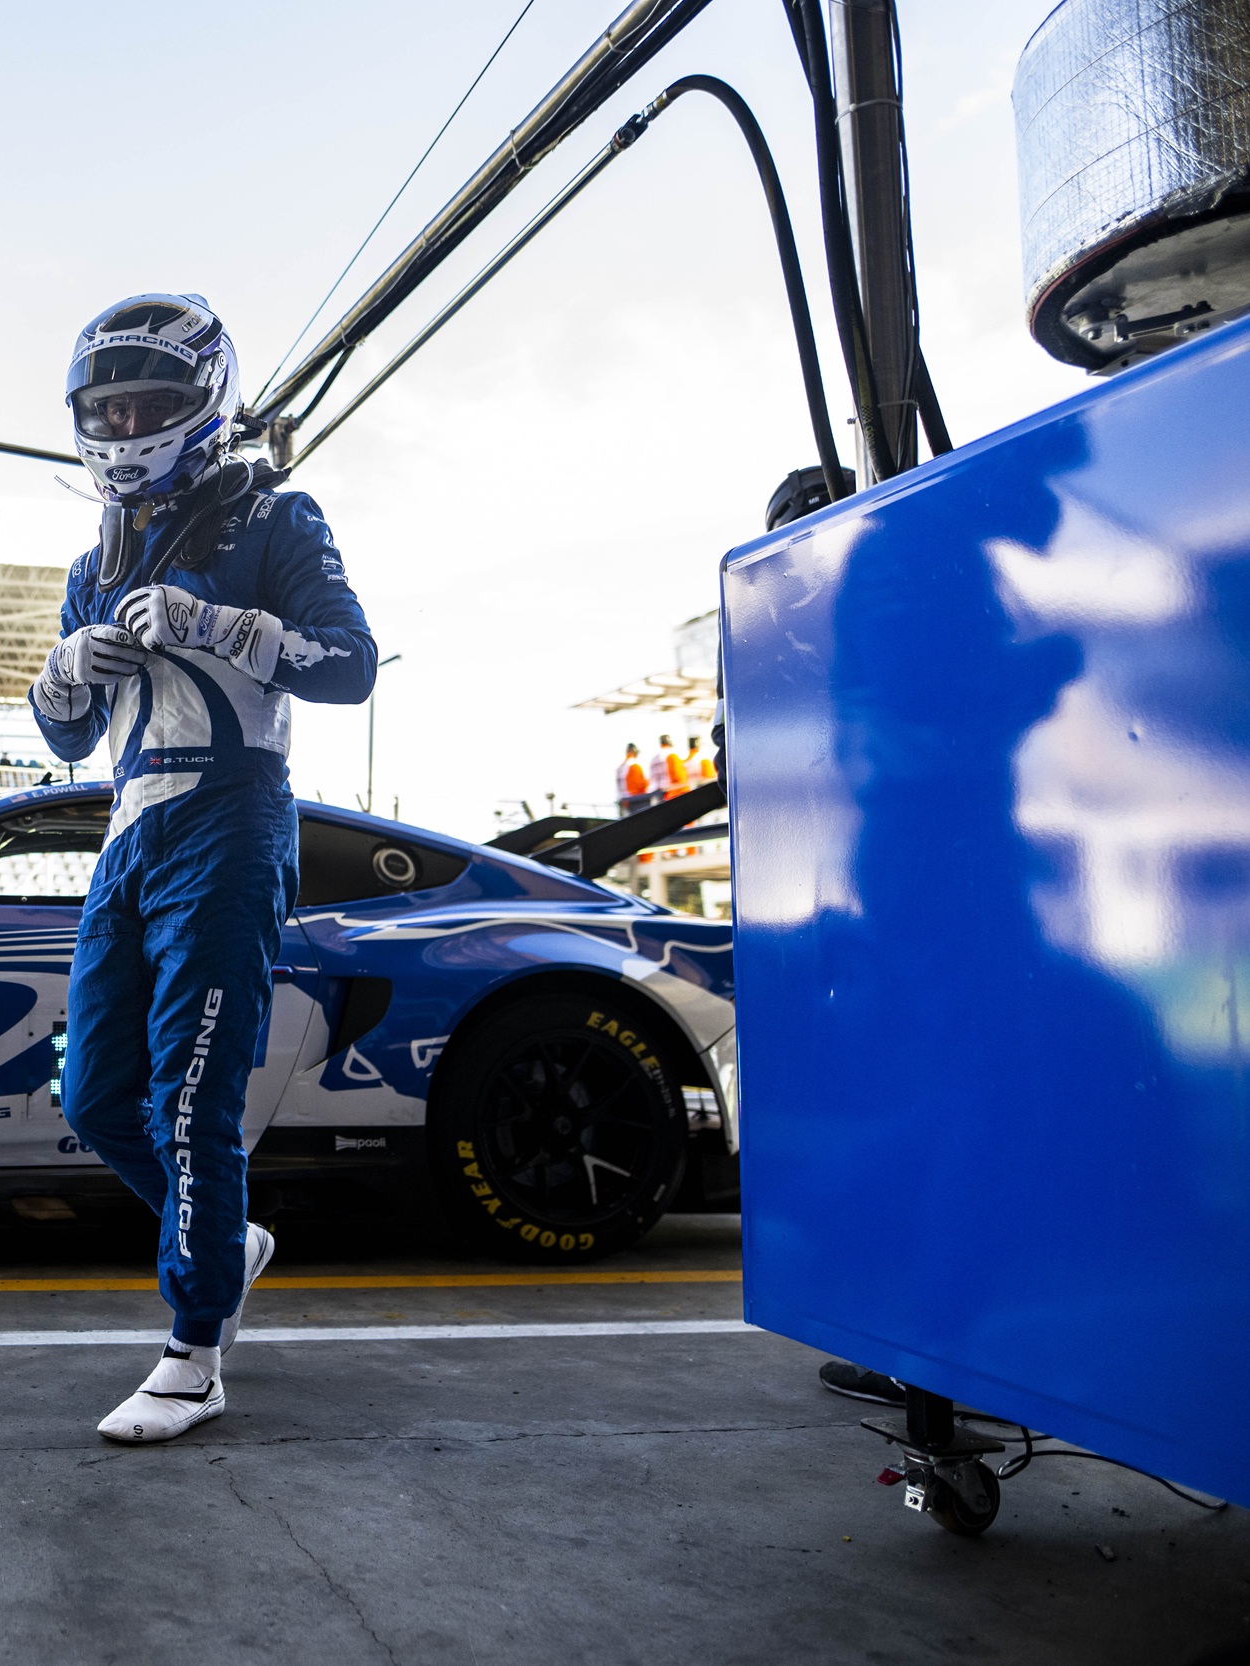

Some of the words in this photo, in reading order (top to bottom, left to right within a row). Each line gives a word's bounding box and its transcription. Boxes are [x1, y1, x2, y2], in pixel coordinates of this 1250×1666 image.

[108, 334, 194, 361] RACING
[111, 467, 139, 481] Ford
[230, 611, 257, 659] sparco
[44, 783, 88, 796] POWELL
[586, 1011, 661, 1073] EAGLE
[175, 988, 223, 1144] RACING
[357, 1137, 386, 1150] paoli
[176, 1149, 194, 1259] FORD
